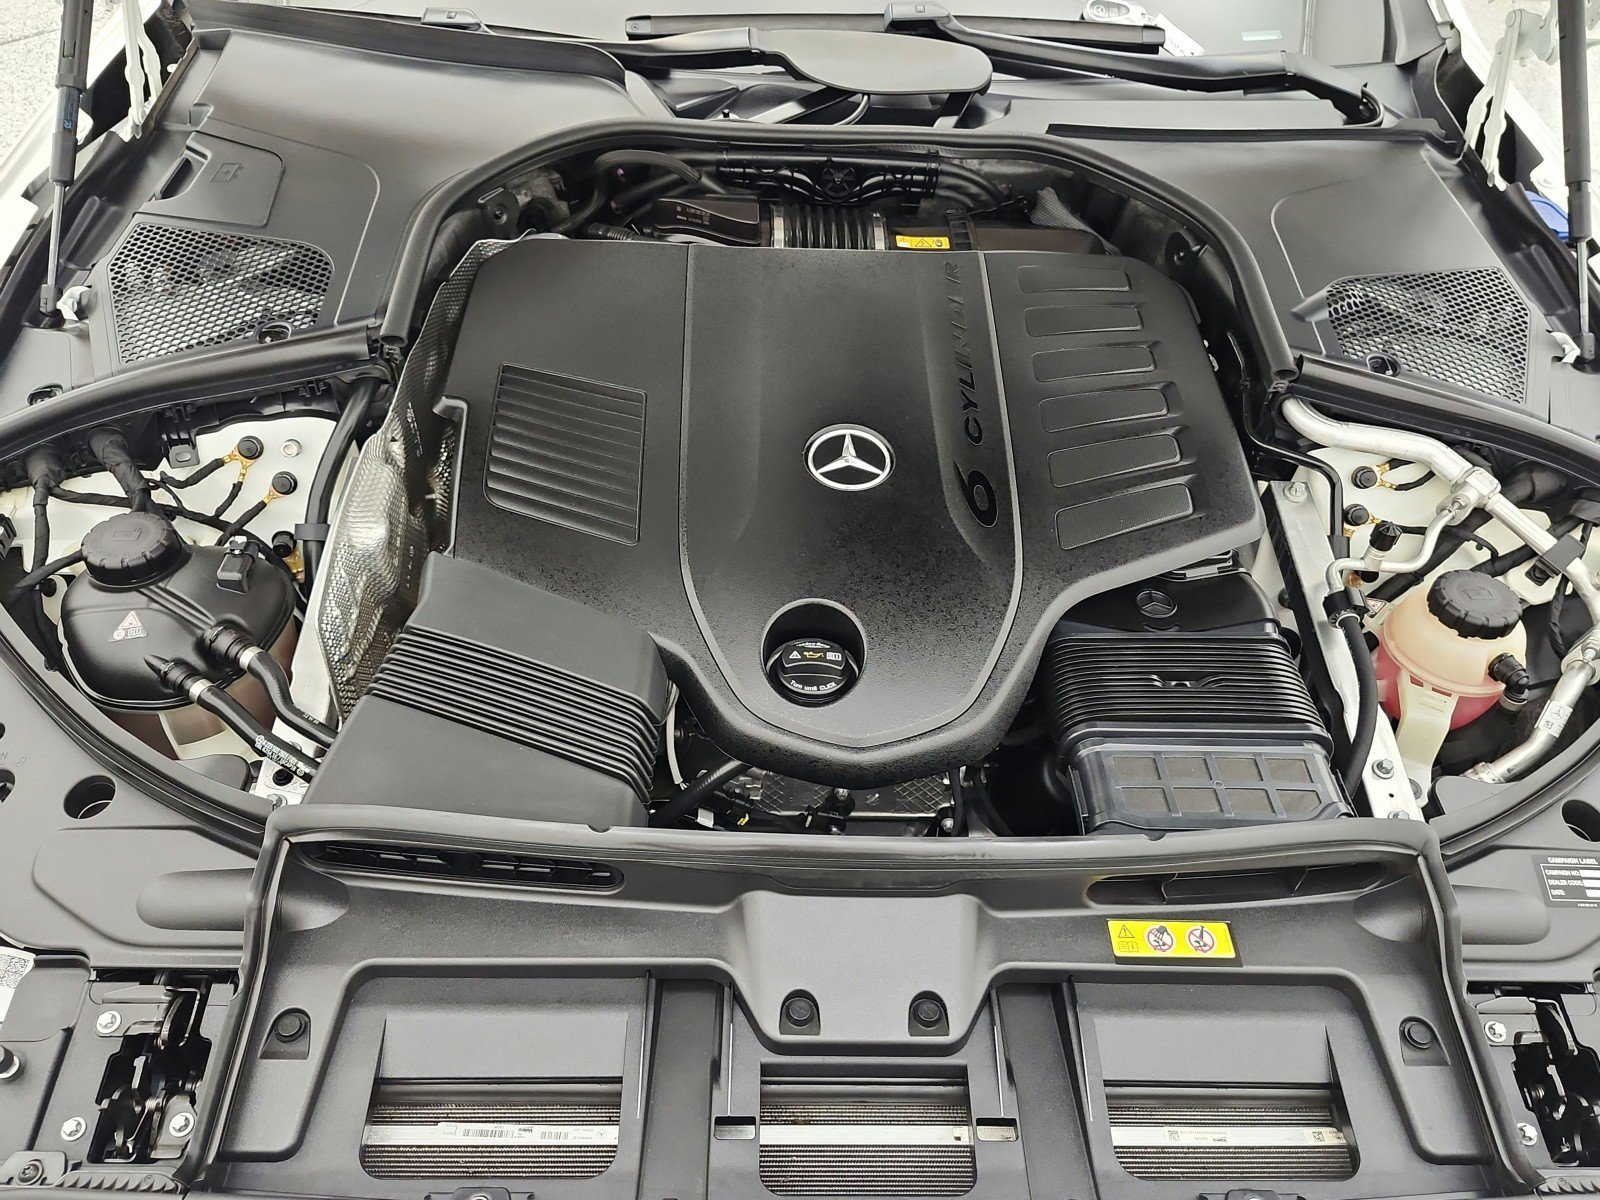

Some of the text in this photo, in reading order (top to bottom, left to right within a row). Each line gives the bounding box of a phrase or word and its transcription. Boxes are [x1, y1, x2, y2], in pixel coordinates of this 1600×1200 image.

[944, 260, 999, 528] 6 CYLINDER
[790, 680, 802, 689] Turn
[819, 682, 836, 690] CLICK
